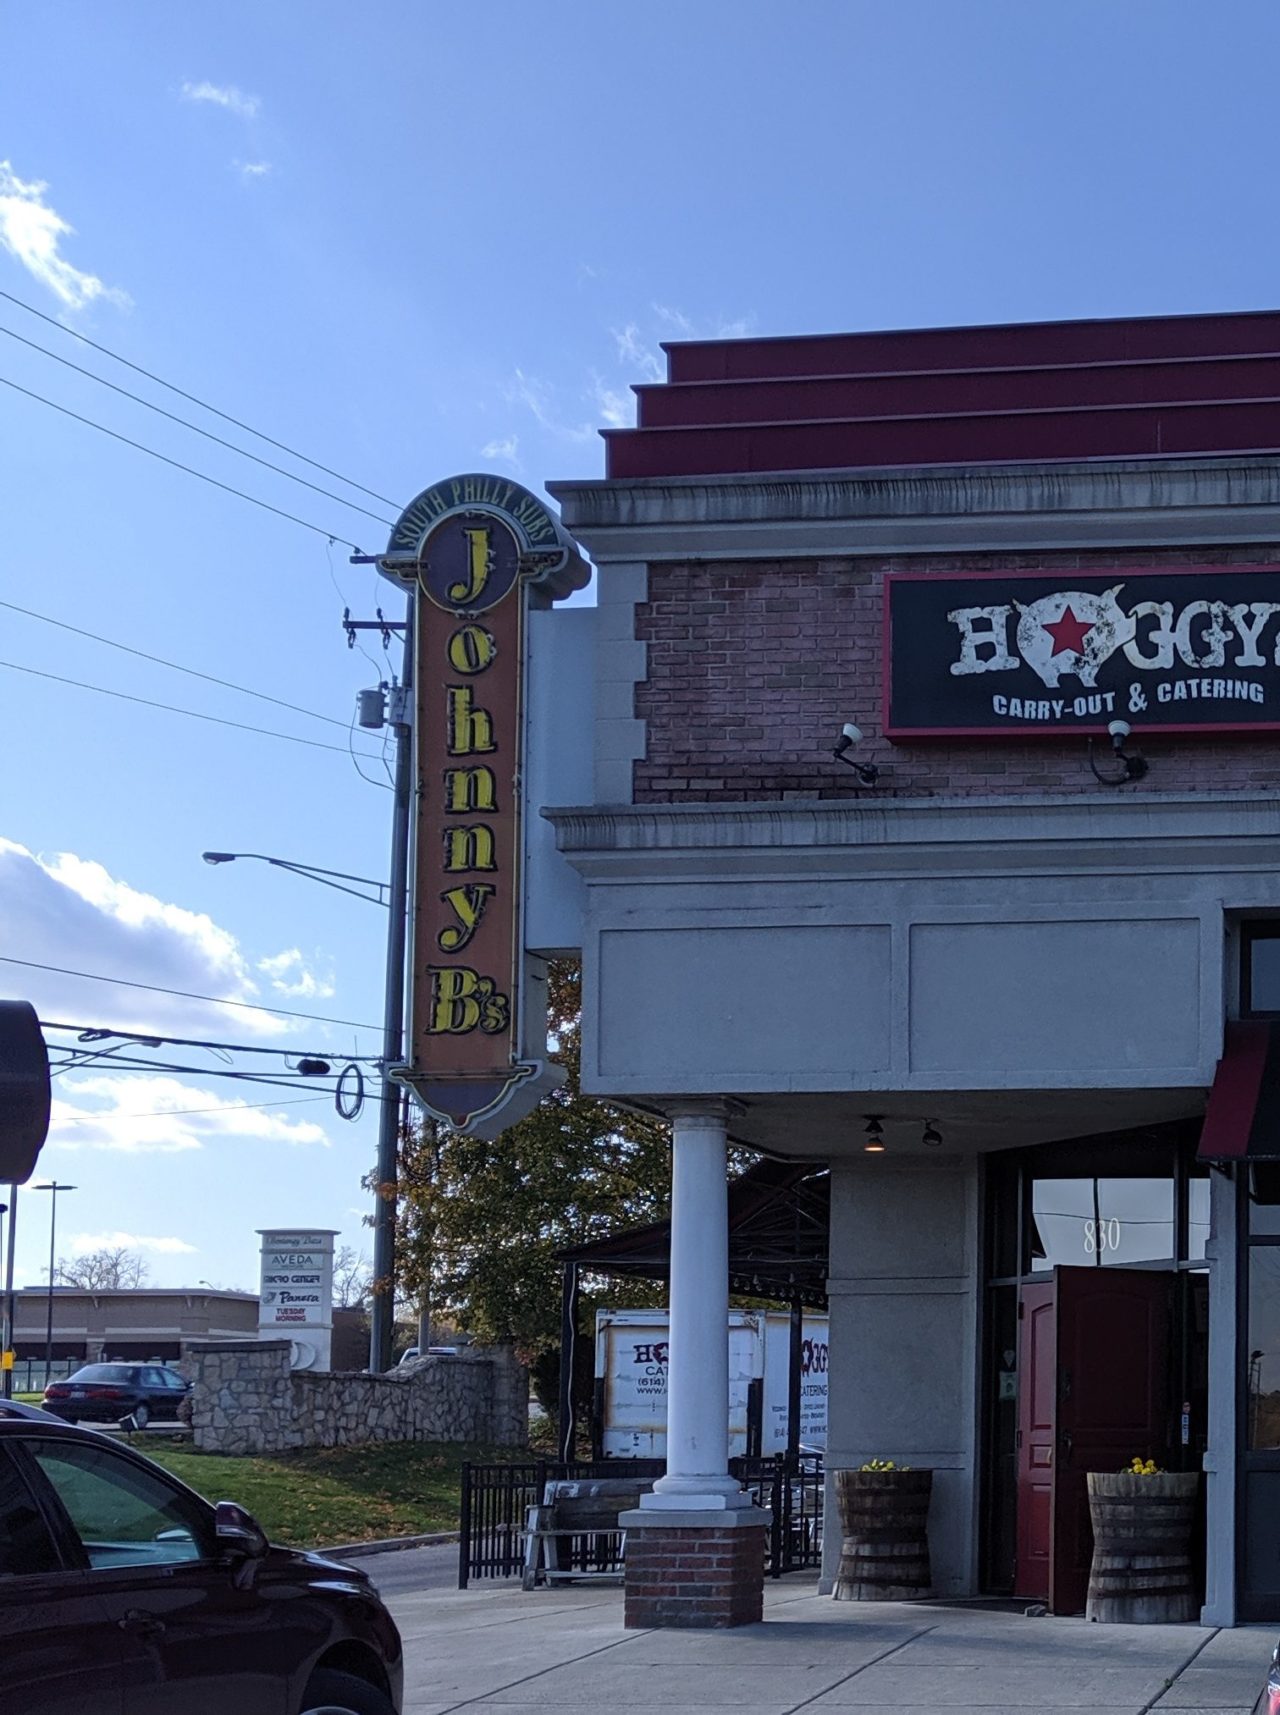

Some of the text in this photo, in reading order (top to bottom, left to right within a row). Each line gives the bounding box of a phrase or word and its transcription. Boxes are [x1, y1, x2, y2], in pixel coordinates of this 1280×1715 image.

[395, 477, 554, 547] SOUTH PHILLY SUBS
[993, 678, 1265, 720] CARRY-OUT & CATERING
[1084, 1217, 1121, 1253] 830
[271, 1254, 314, 1265] AVEDA
[279, 1290, 321, 1305] Panera
[800, 1384, 828, 1397] ATERING
